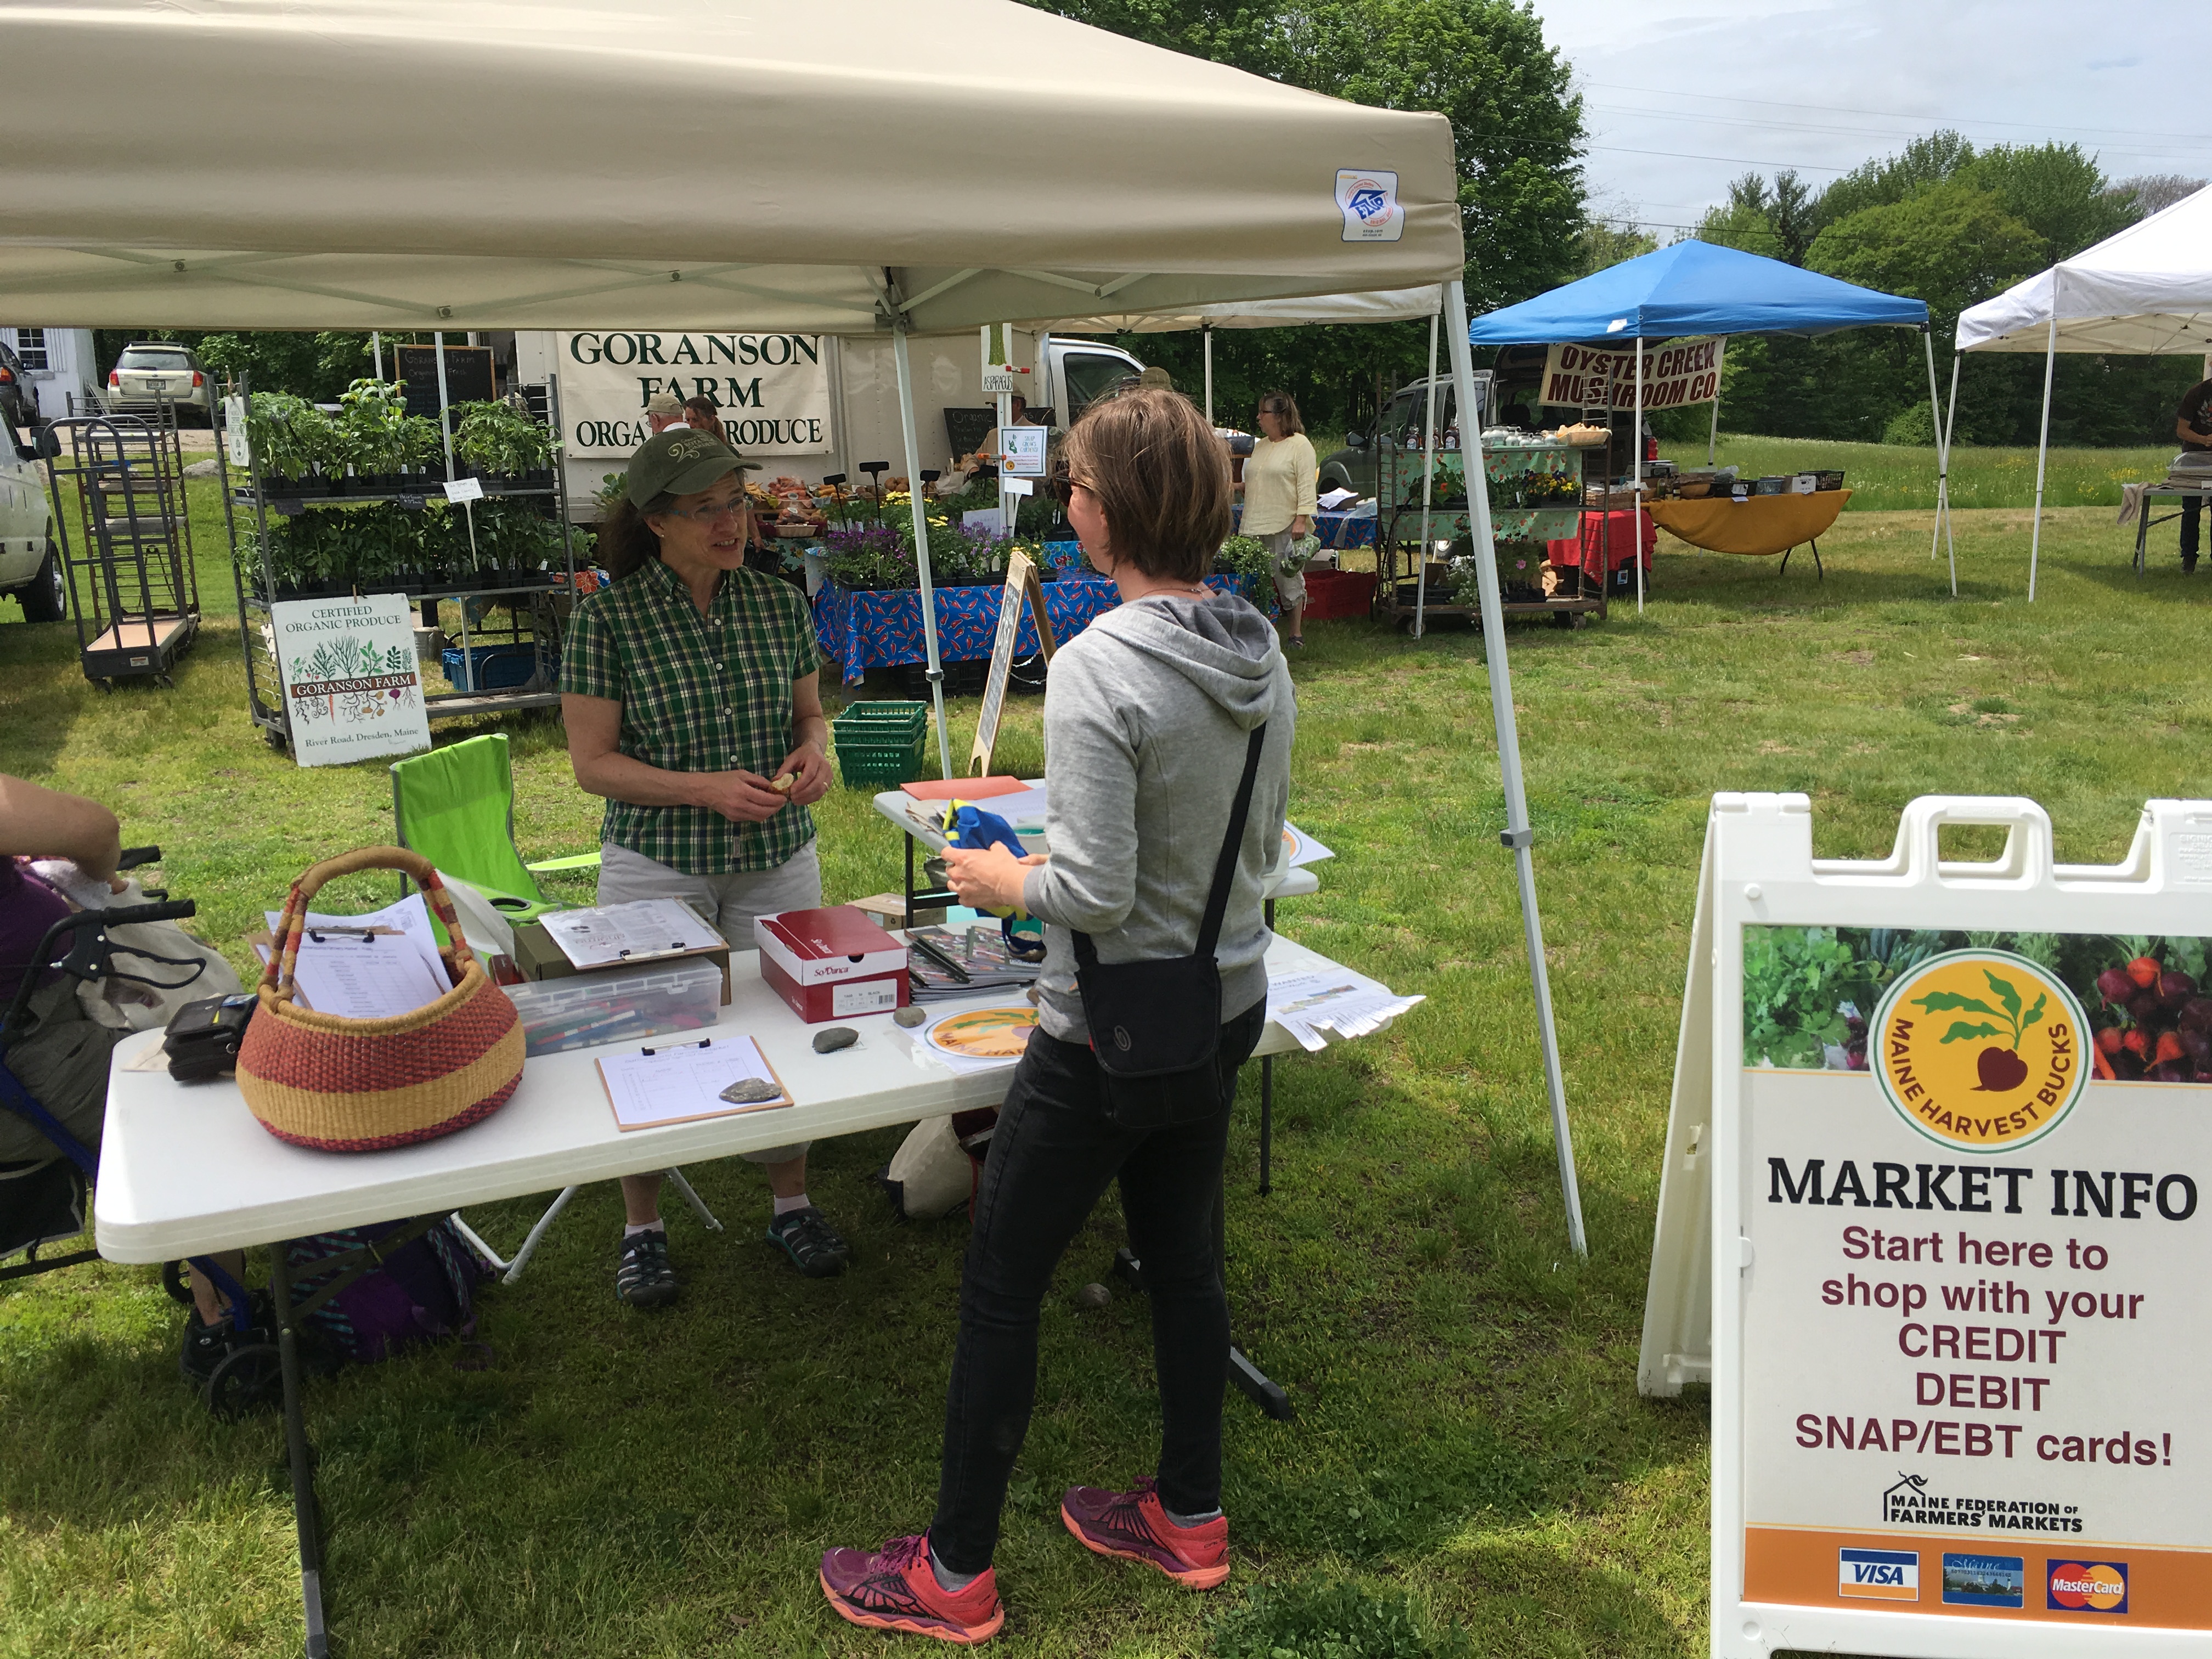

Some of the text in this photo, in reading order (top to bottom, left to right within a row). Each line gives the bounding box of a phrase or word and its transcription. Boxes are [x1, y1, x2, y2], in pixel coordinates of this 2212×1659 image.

[571, 332, 821, 365] GORANSON
[1560, 341, 1717, 381] OYSTER CREEK
[637, 376, 765, 408] FARM
[983, 375, 1013, 390] ASPARAGUS
[1547, 371, 1717, 408] MUSHROOM CO.
[953, 411, 992, 426] Organic
[723, 418, 823, 446] RODUCE
[286, 615, 402, 633] ORGANIC PRODUCE
[312, 606, 373, 619] CERTIFIED
[296, 675, 411, 696] GORANSON FARM
[306, 729, 419, 747] River Road, Dresden, Maine
[939, 1032, 983, 1054] MAINE
[1891, 1018, 2071, 1137] MAINE HARVEST BUCKS
[1768, 1157, 2198, 1221] MARKET INFO
[1843, 1226, 2108, 1271] Start here to
[1822, 1273, 2145, 1325] shop with your
[1899, 1323, 2067, 1364] CREDIT
[1916, 1373, 2050, 1412] DEBIT
[1796, 1414, 2172, 1466] SNAP/EBT cards!
[1892, 1495, 2078, 1515] MAINE FEDERATION OF
[1989, 1514, 2083, 1533] MARKETS
[1852, 1564, 1903, 1585] VISA
[1952, 1559, 2001, 1570] Maine
[2052, 1578, 2123, 1595] MasterCard
